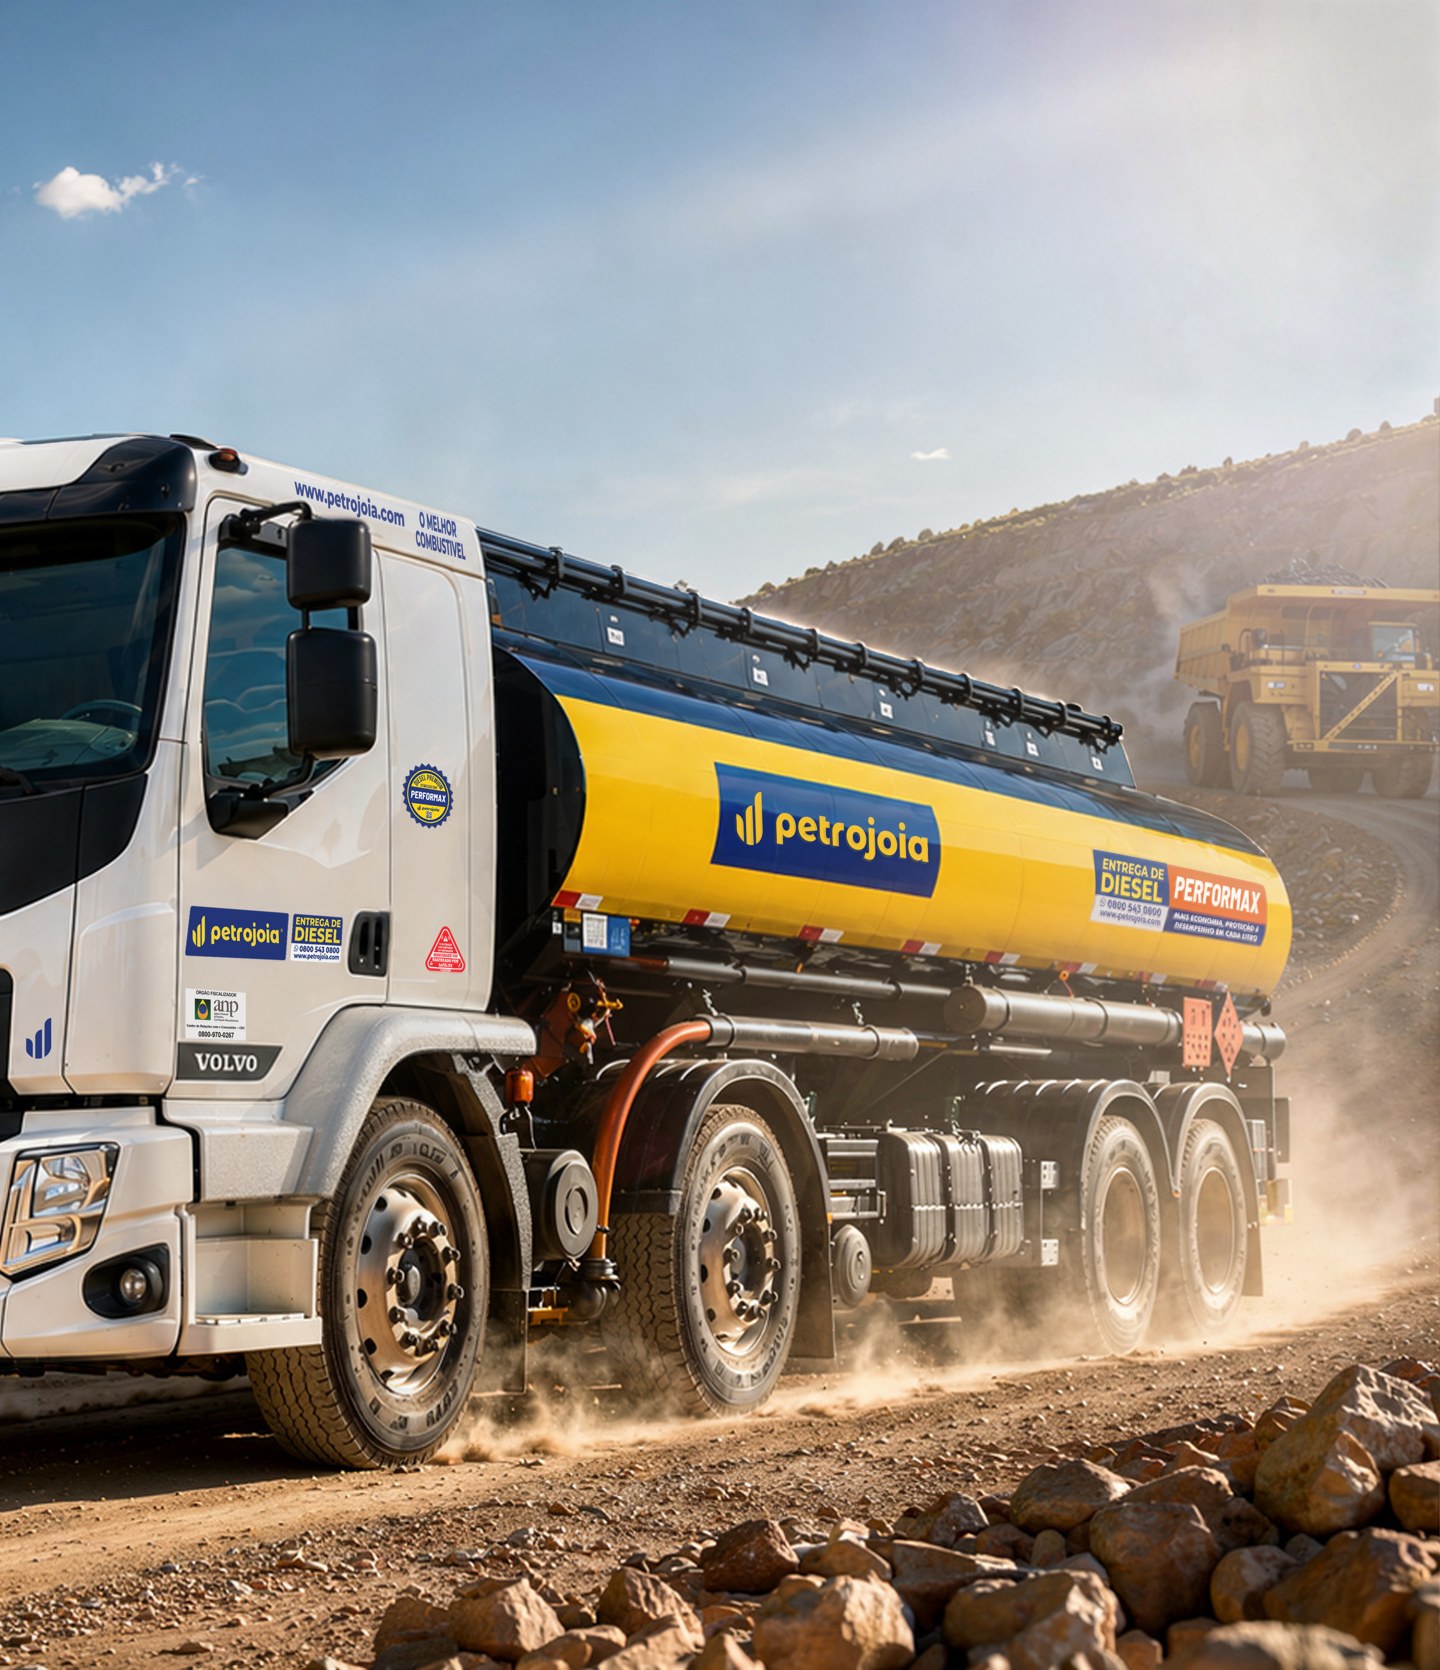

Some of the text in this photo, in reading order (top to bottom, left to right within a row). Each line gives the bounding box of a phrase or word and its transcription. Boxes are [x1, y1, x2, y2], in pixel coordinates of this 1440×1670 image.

[294, 481, 405, 527] www.petrojoia.com
[419, 511, 457, 538] O MELHOR
[415, 530, 466, 561] COMBUSTIVEL
[411, 790, 446, 803] PERFORMAX
[775, 812, 929, 863] petrojoia
[1102, 858, 1165, 881] ENTREGA DE
[1100, 872, 1163, 903] DIESEL
[1174, 876, 1261, 914] PERFORMAX
[1099, 909, 1161, 927] www.petrojoia.com
[1107, 900, 1162, 917] 0800 543 0800
[1173, 912, 1190, 921] MAIS
[295, 916, 342, 928] ENTREGA DE
[210, 921, 280, 947] petrojoia
[294, 926, 341, 944] DIESEL
[1173, 921, 1215, 935] DESEMPENHO
[1225, 930, 1241, 939] CADA
[1241, 933, 1258, 943] LITRO
[293, 952, 340, 961] www.petrojoia.com
[299, 945, 314, 953] 0800
[325, 946, 340, 954] 0800
[213, 999, 239, 1018] anp
[194, 1053, 257, 1072] VOLVO
